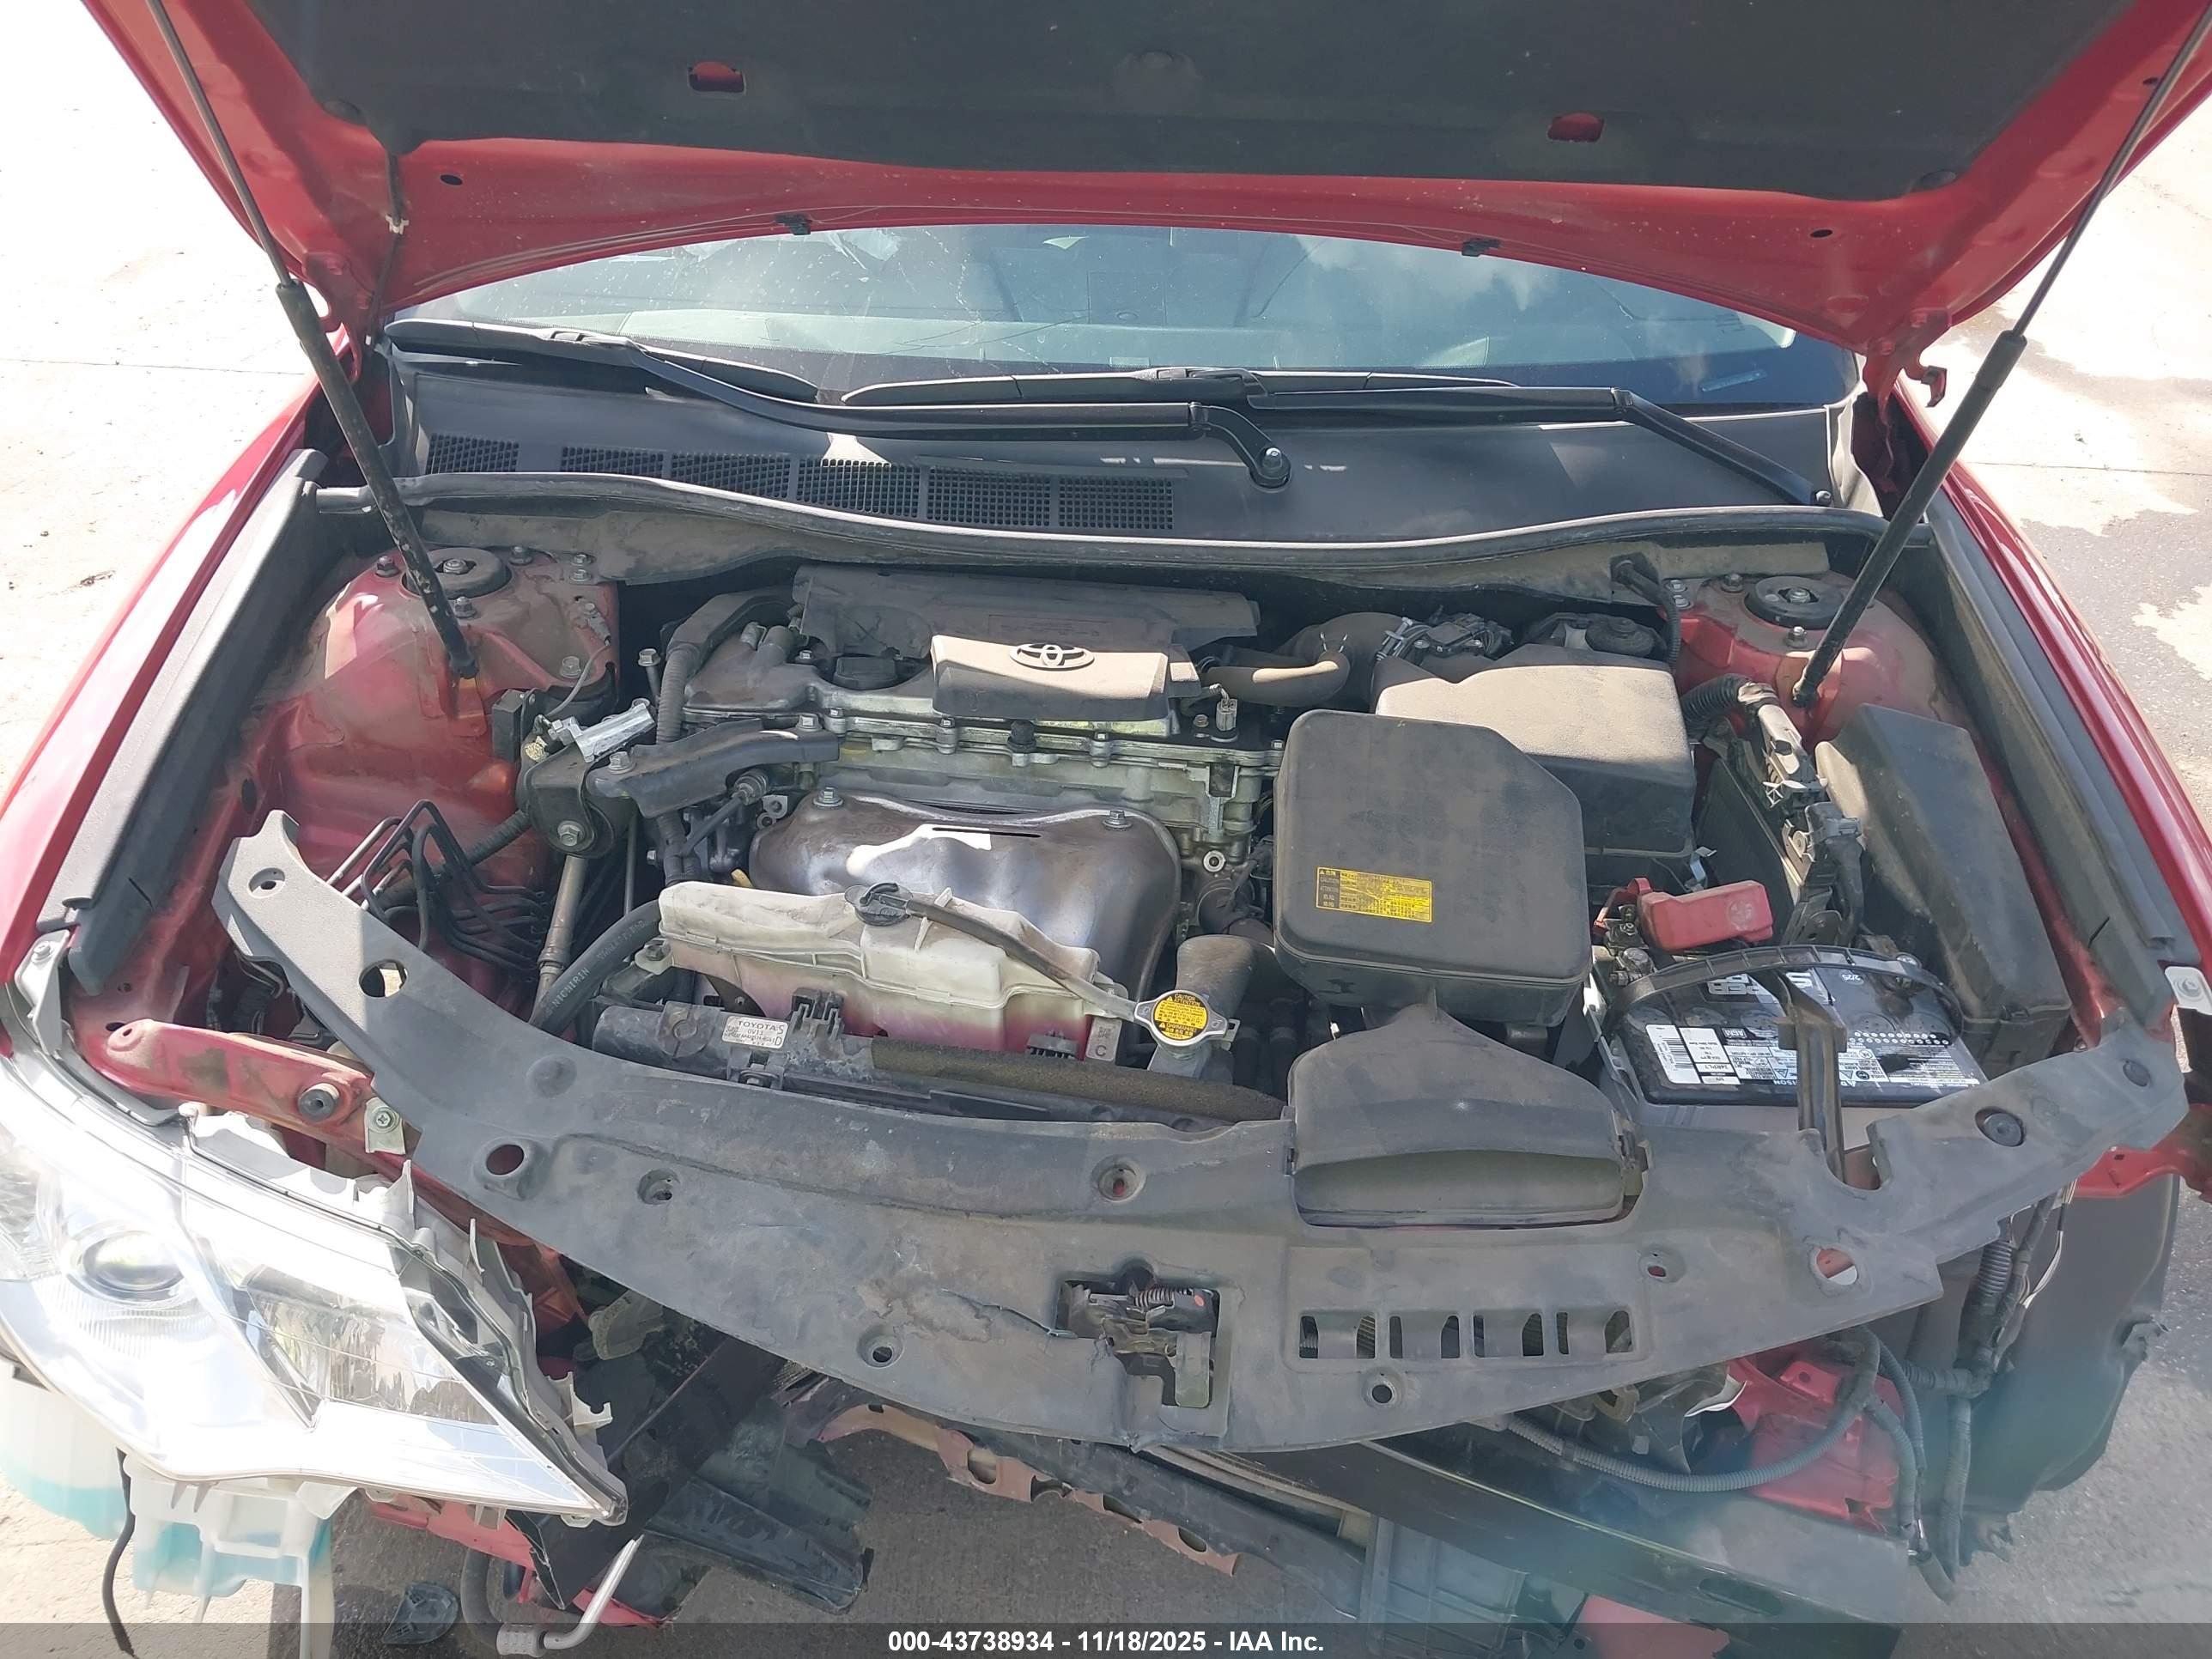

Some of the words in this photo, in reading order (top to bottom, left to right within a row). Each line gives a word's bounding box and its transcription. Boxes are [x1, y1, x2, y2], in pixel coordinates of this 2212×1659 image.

[552, 967, 590, 1007] NICHIRIN
[1174, 994, 1196, 1002] CAUTION
[738, 1020, 776, 1031] TOYOTA
[777, 1024, 785, 1035] S
[775, 1036, 783, 1046] D
[1096, 1045, 1107, 1056] C
